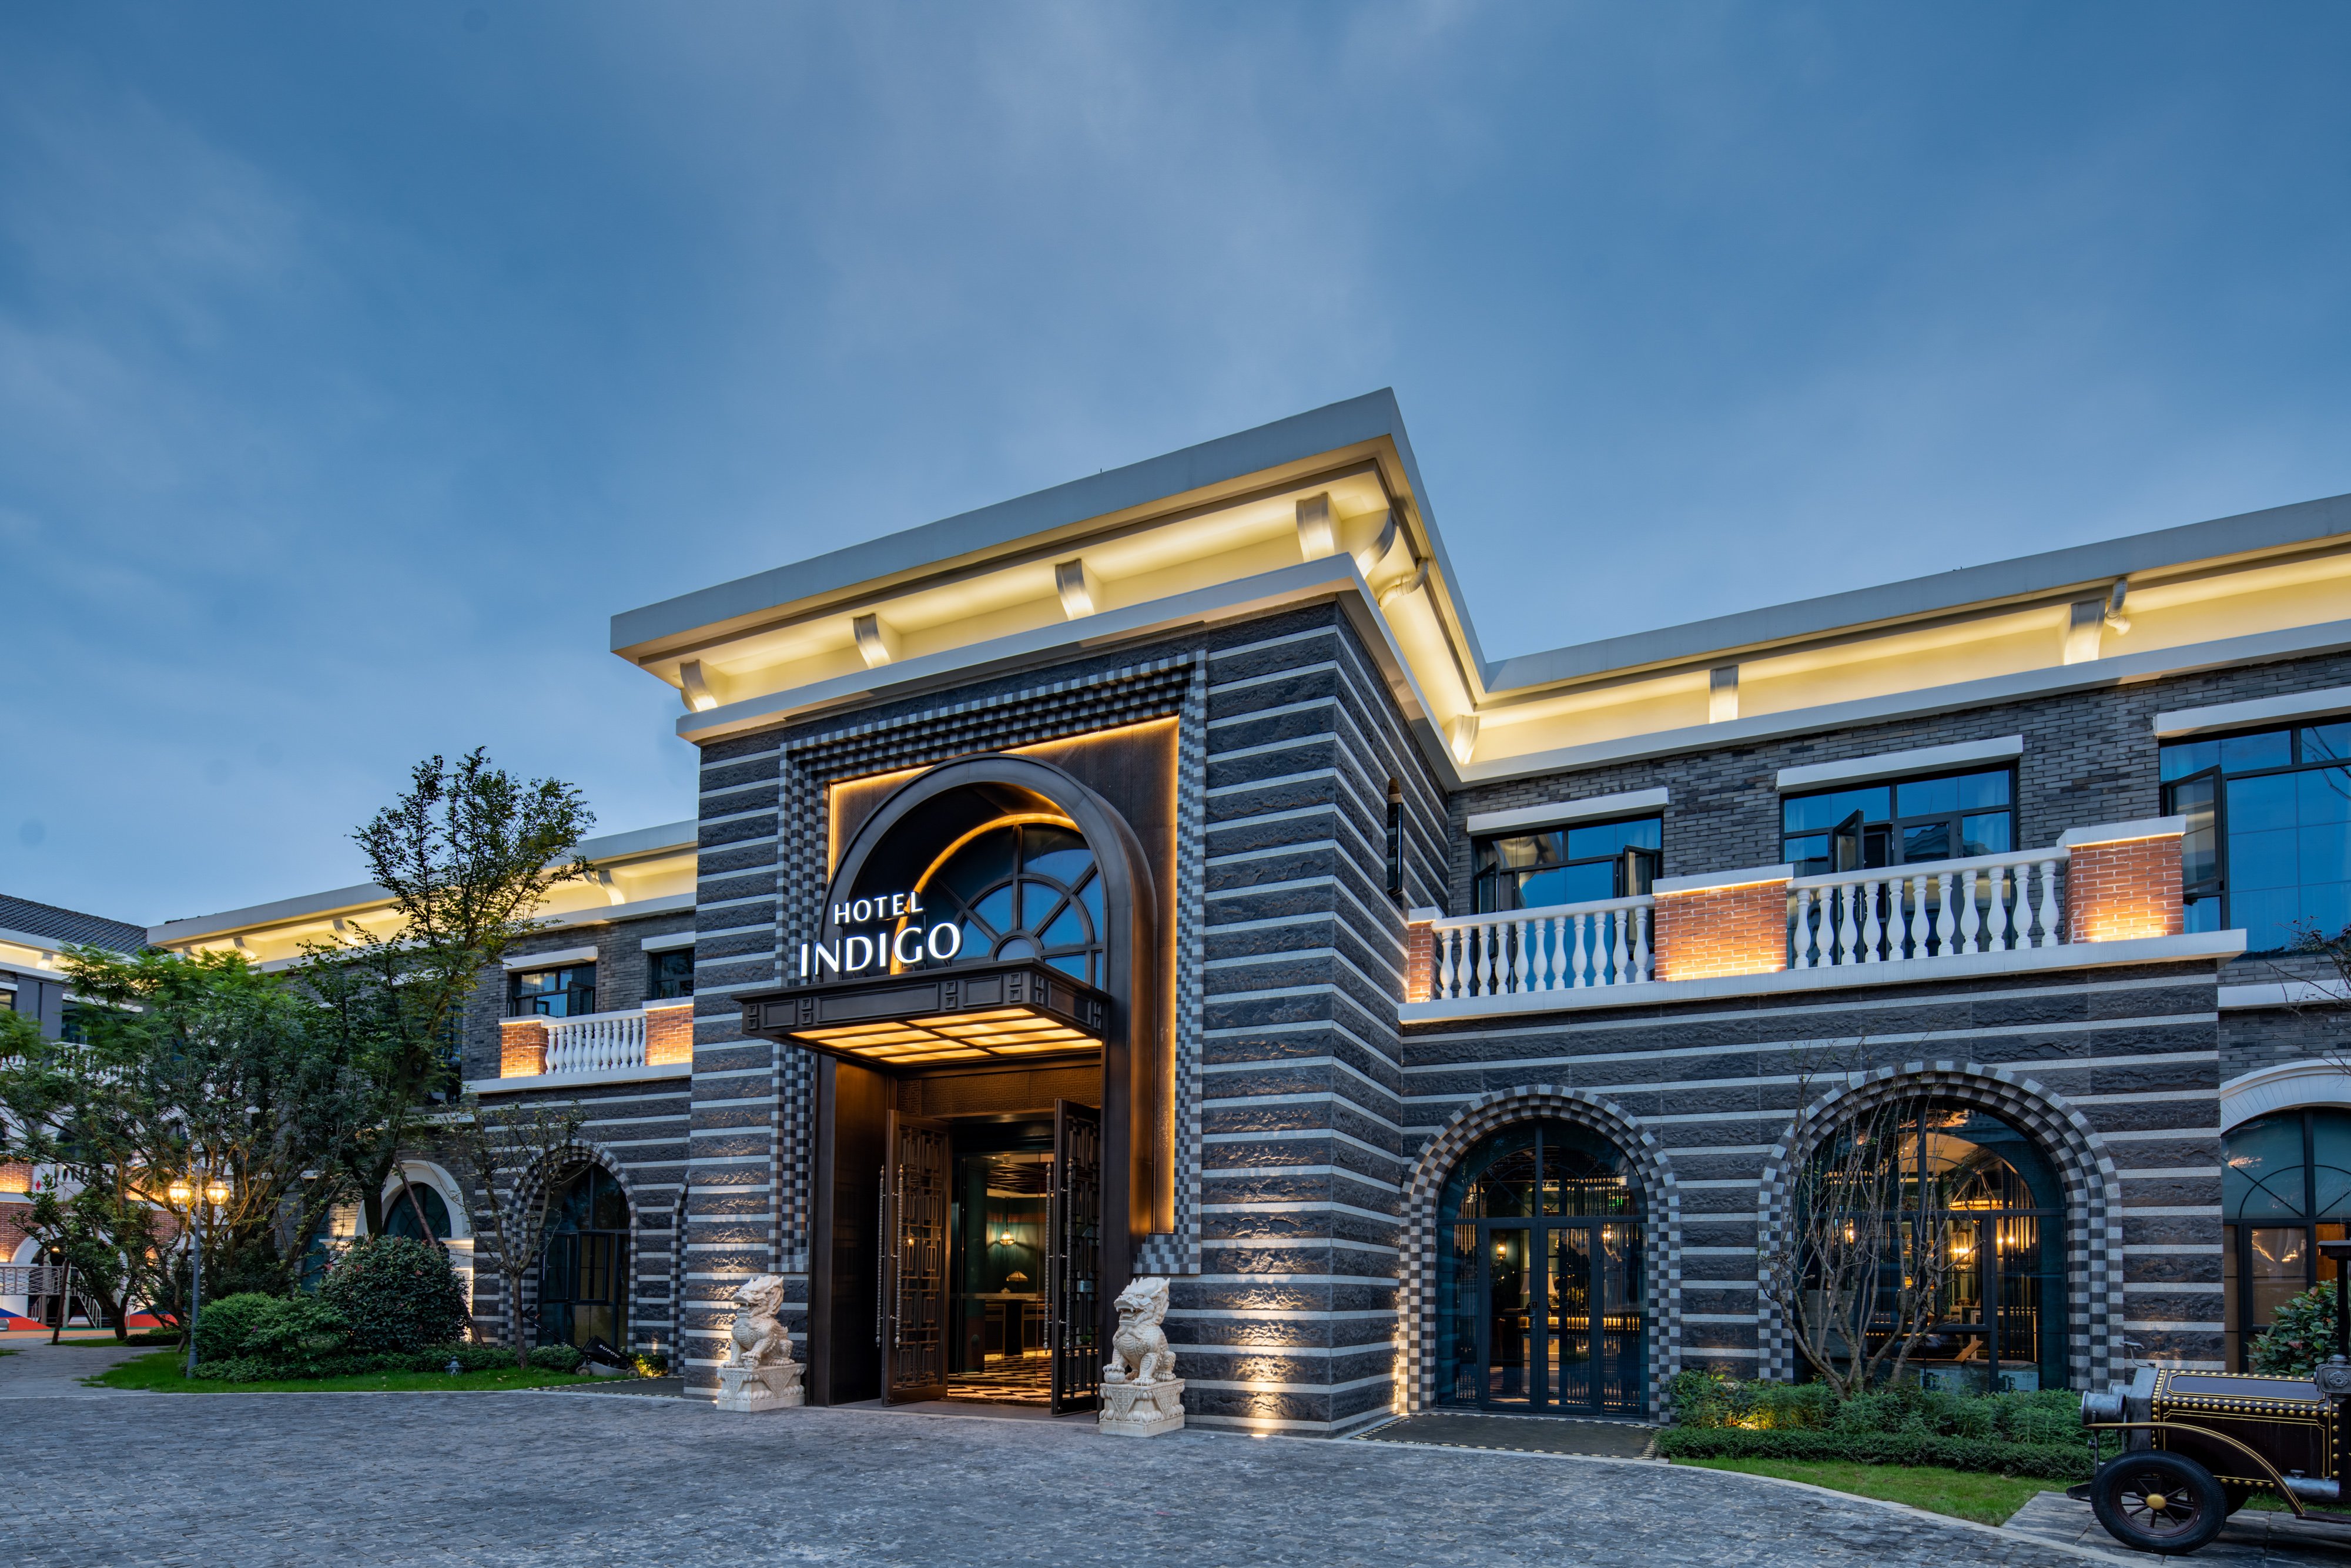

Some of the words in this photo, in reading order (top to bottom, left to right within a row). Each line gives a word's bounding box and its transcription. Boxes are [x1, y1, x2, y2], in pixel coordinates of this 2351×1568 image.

[834, 892, 923, 924] HOTEL
[801, 922, 962, 977] INDIGO
[598, 1344, 621, 1358] SUPOW
